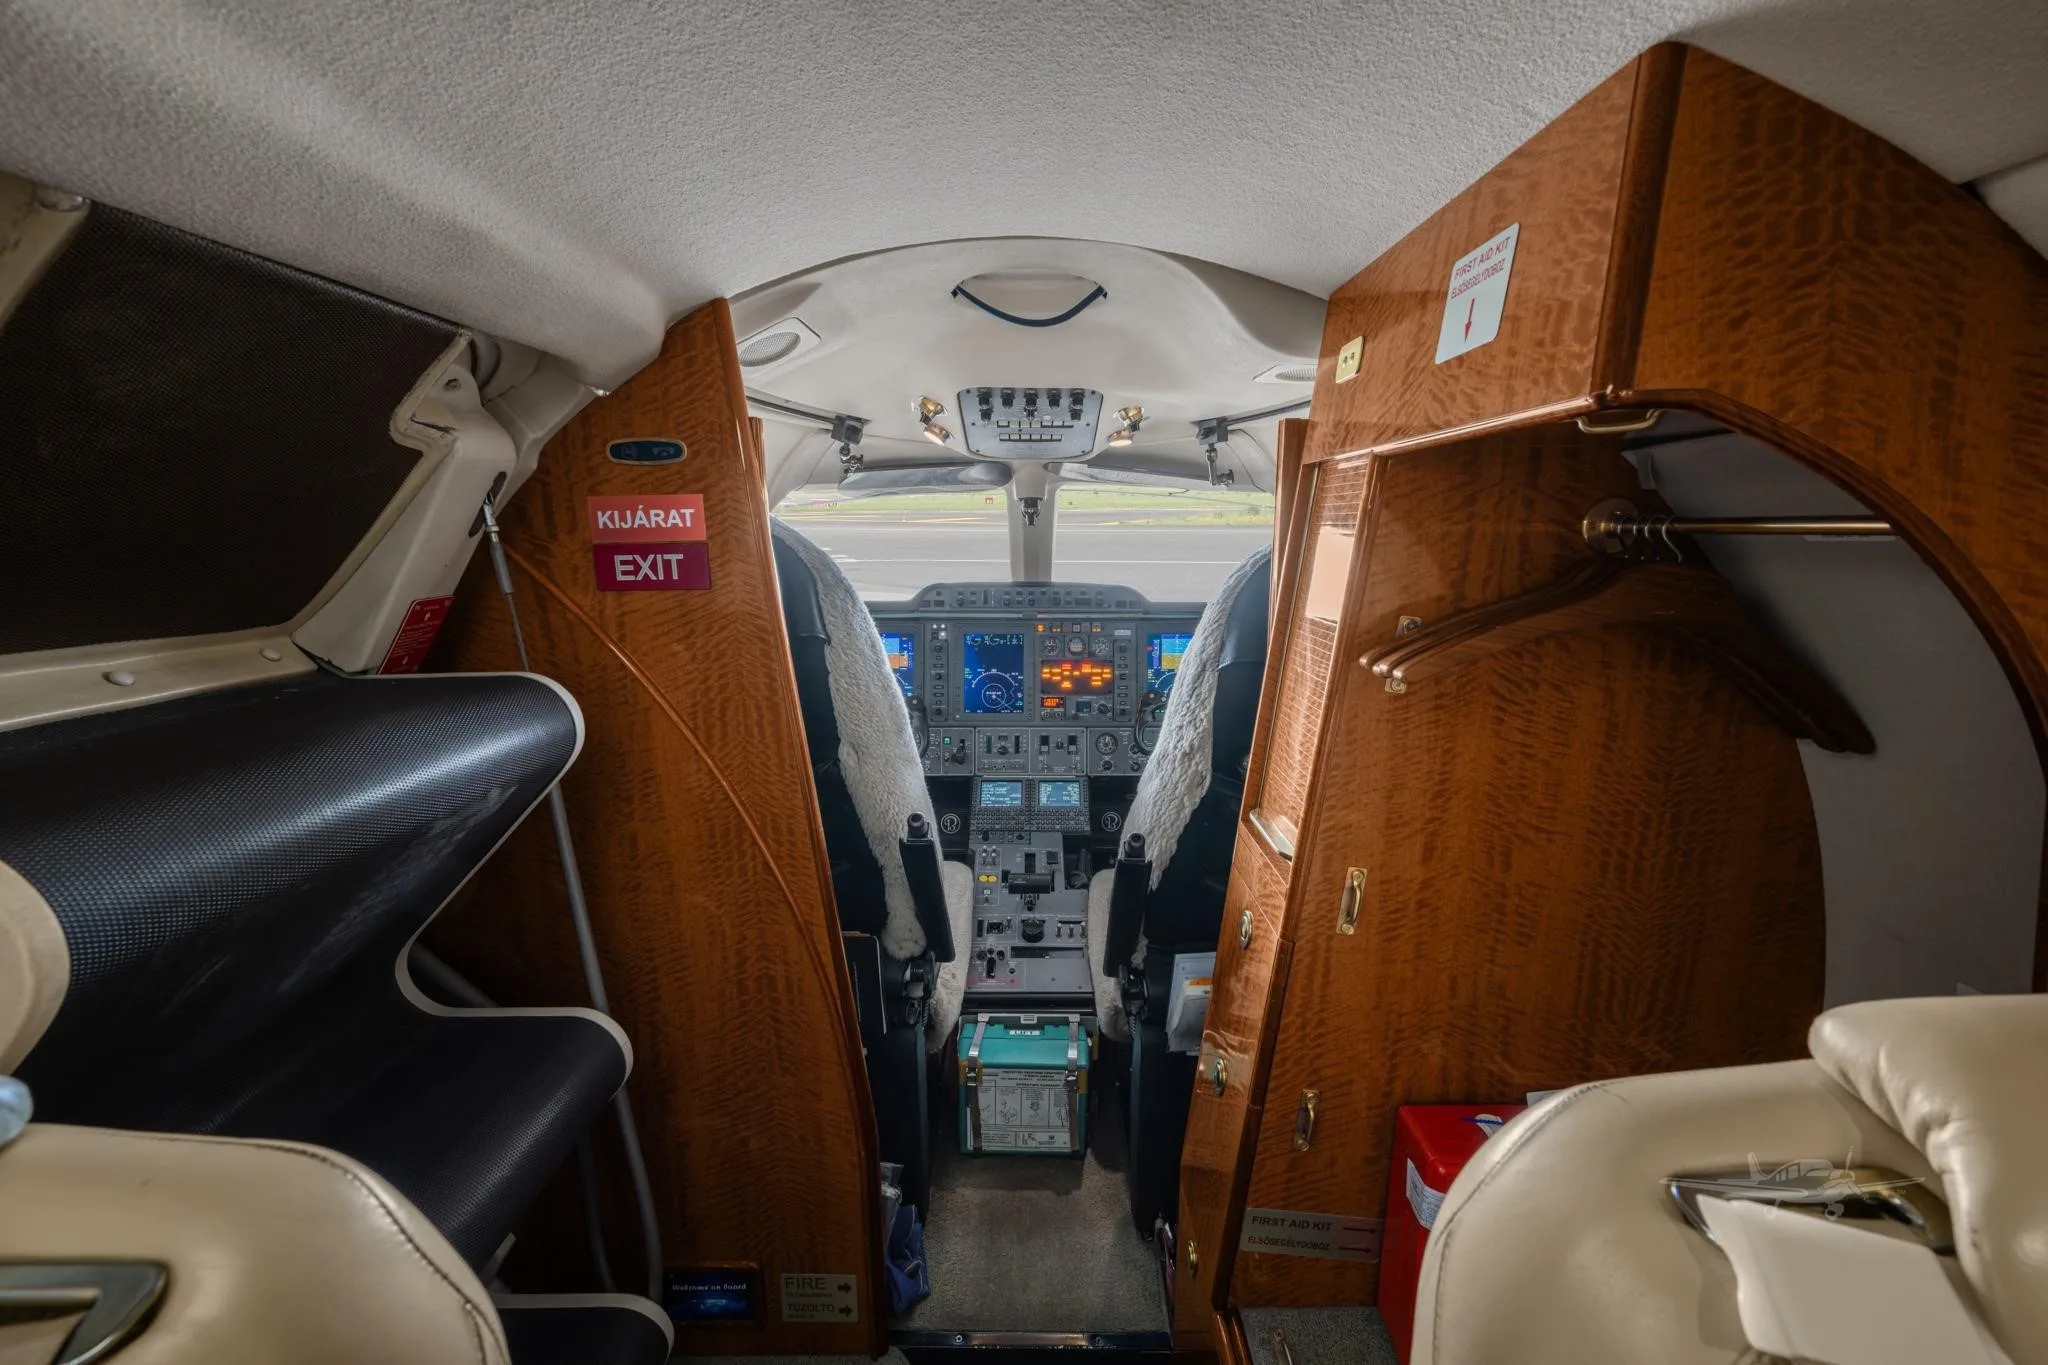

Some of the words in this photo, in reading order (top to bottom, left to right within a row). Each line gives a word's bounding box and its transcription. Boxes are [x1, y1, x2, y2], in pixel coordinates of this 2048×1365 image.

[1455, 257, 1478, 280] FIRST
[1478, 247, 1494, 267] AID
[1494, 236, 1511, 255] KIT
[597, 505, 696, 529] KIJÁRAT
[614, 553, 684, 581] EXIT
[1252, 1216, 1287, 1227] FIRST
[1288, 1219, 1310, 1229] AID
[1313, 1221, 1332, 1231] KIT
[784, 1277, 827, 1290] FIRE
